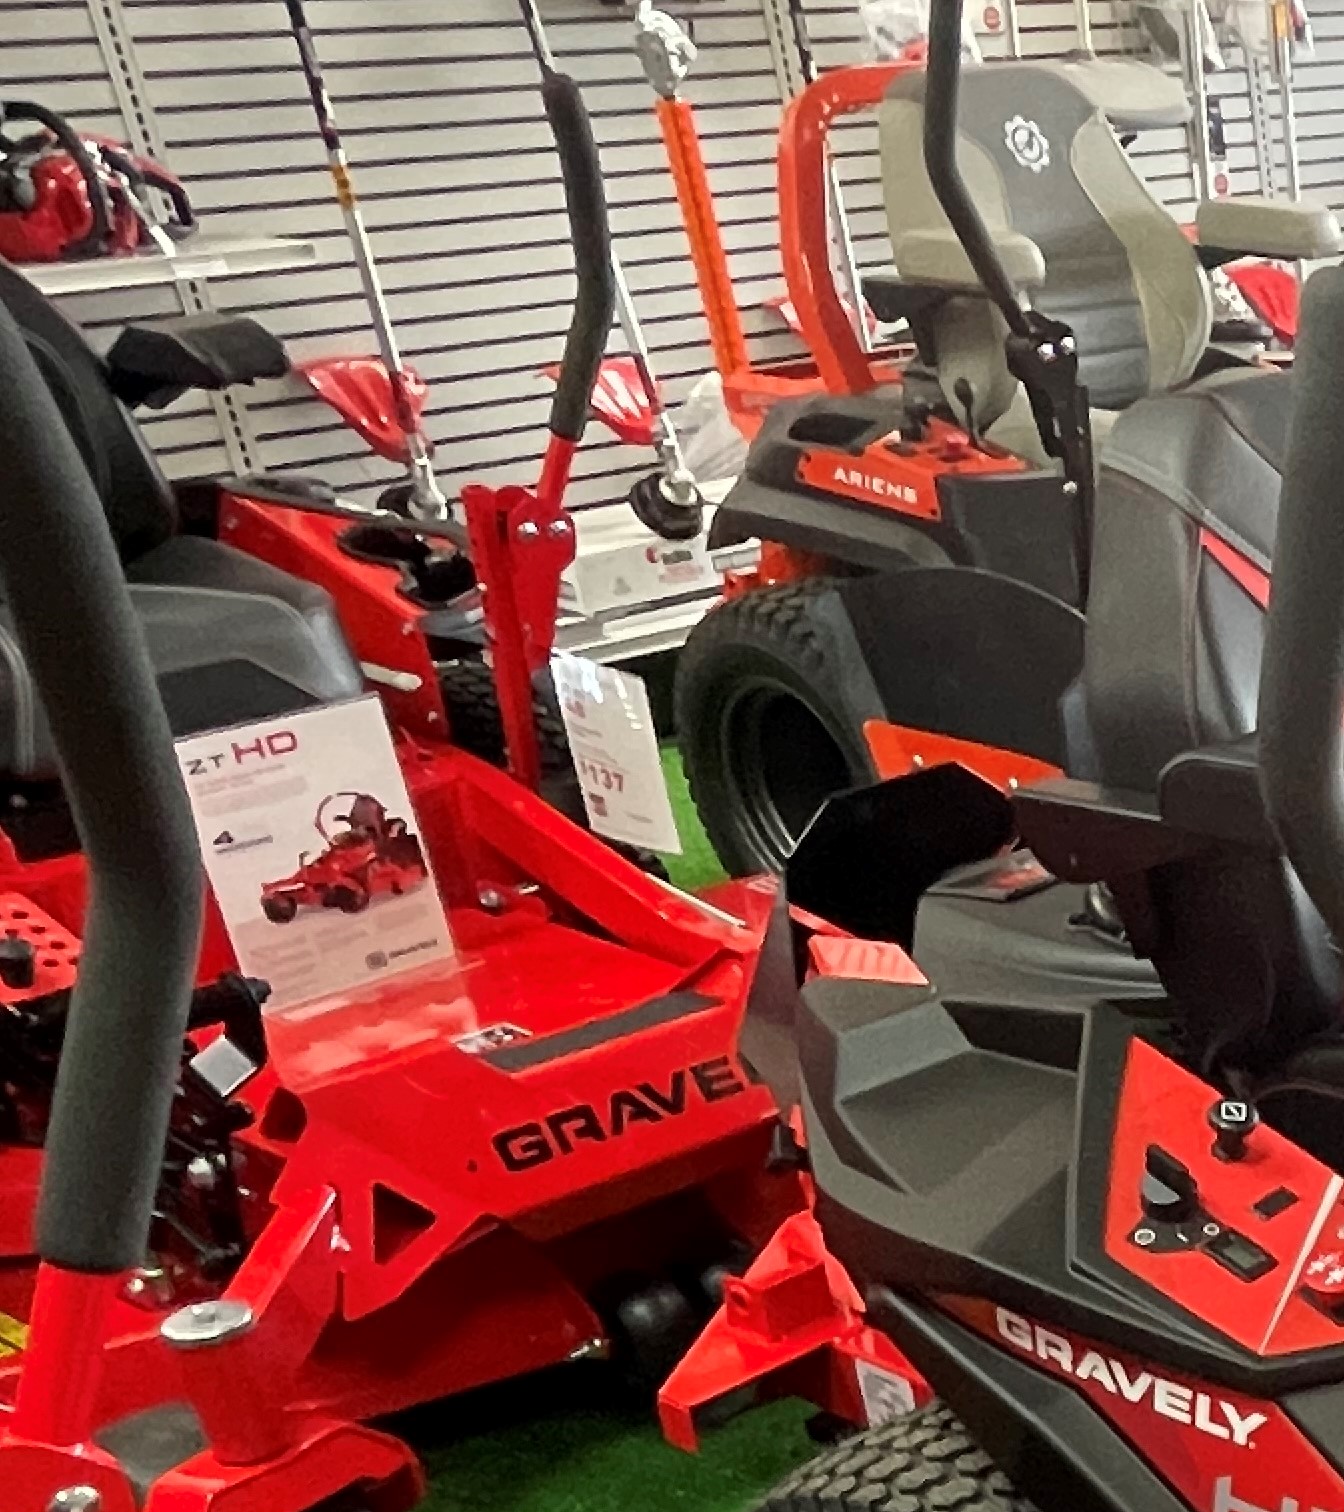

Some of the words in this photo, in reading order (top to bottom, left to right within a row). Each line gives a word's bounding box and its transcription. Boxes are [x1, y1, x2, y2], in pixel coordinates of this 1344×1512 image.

[834, 466, 918, 504] ARIENS
[185, 752, 226, 776] ZT
[230, 730, 298, 765] HD
[492, 1054, 745, 1173] GRAVE
[996, 1306, 1268, 1448] GRAVELY
